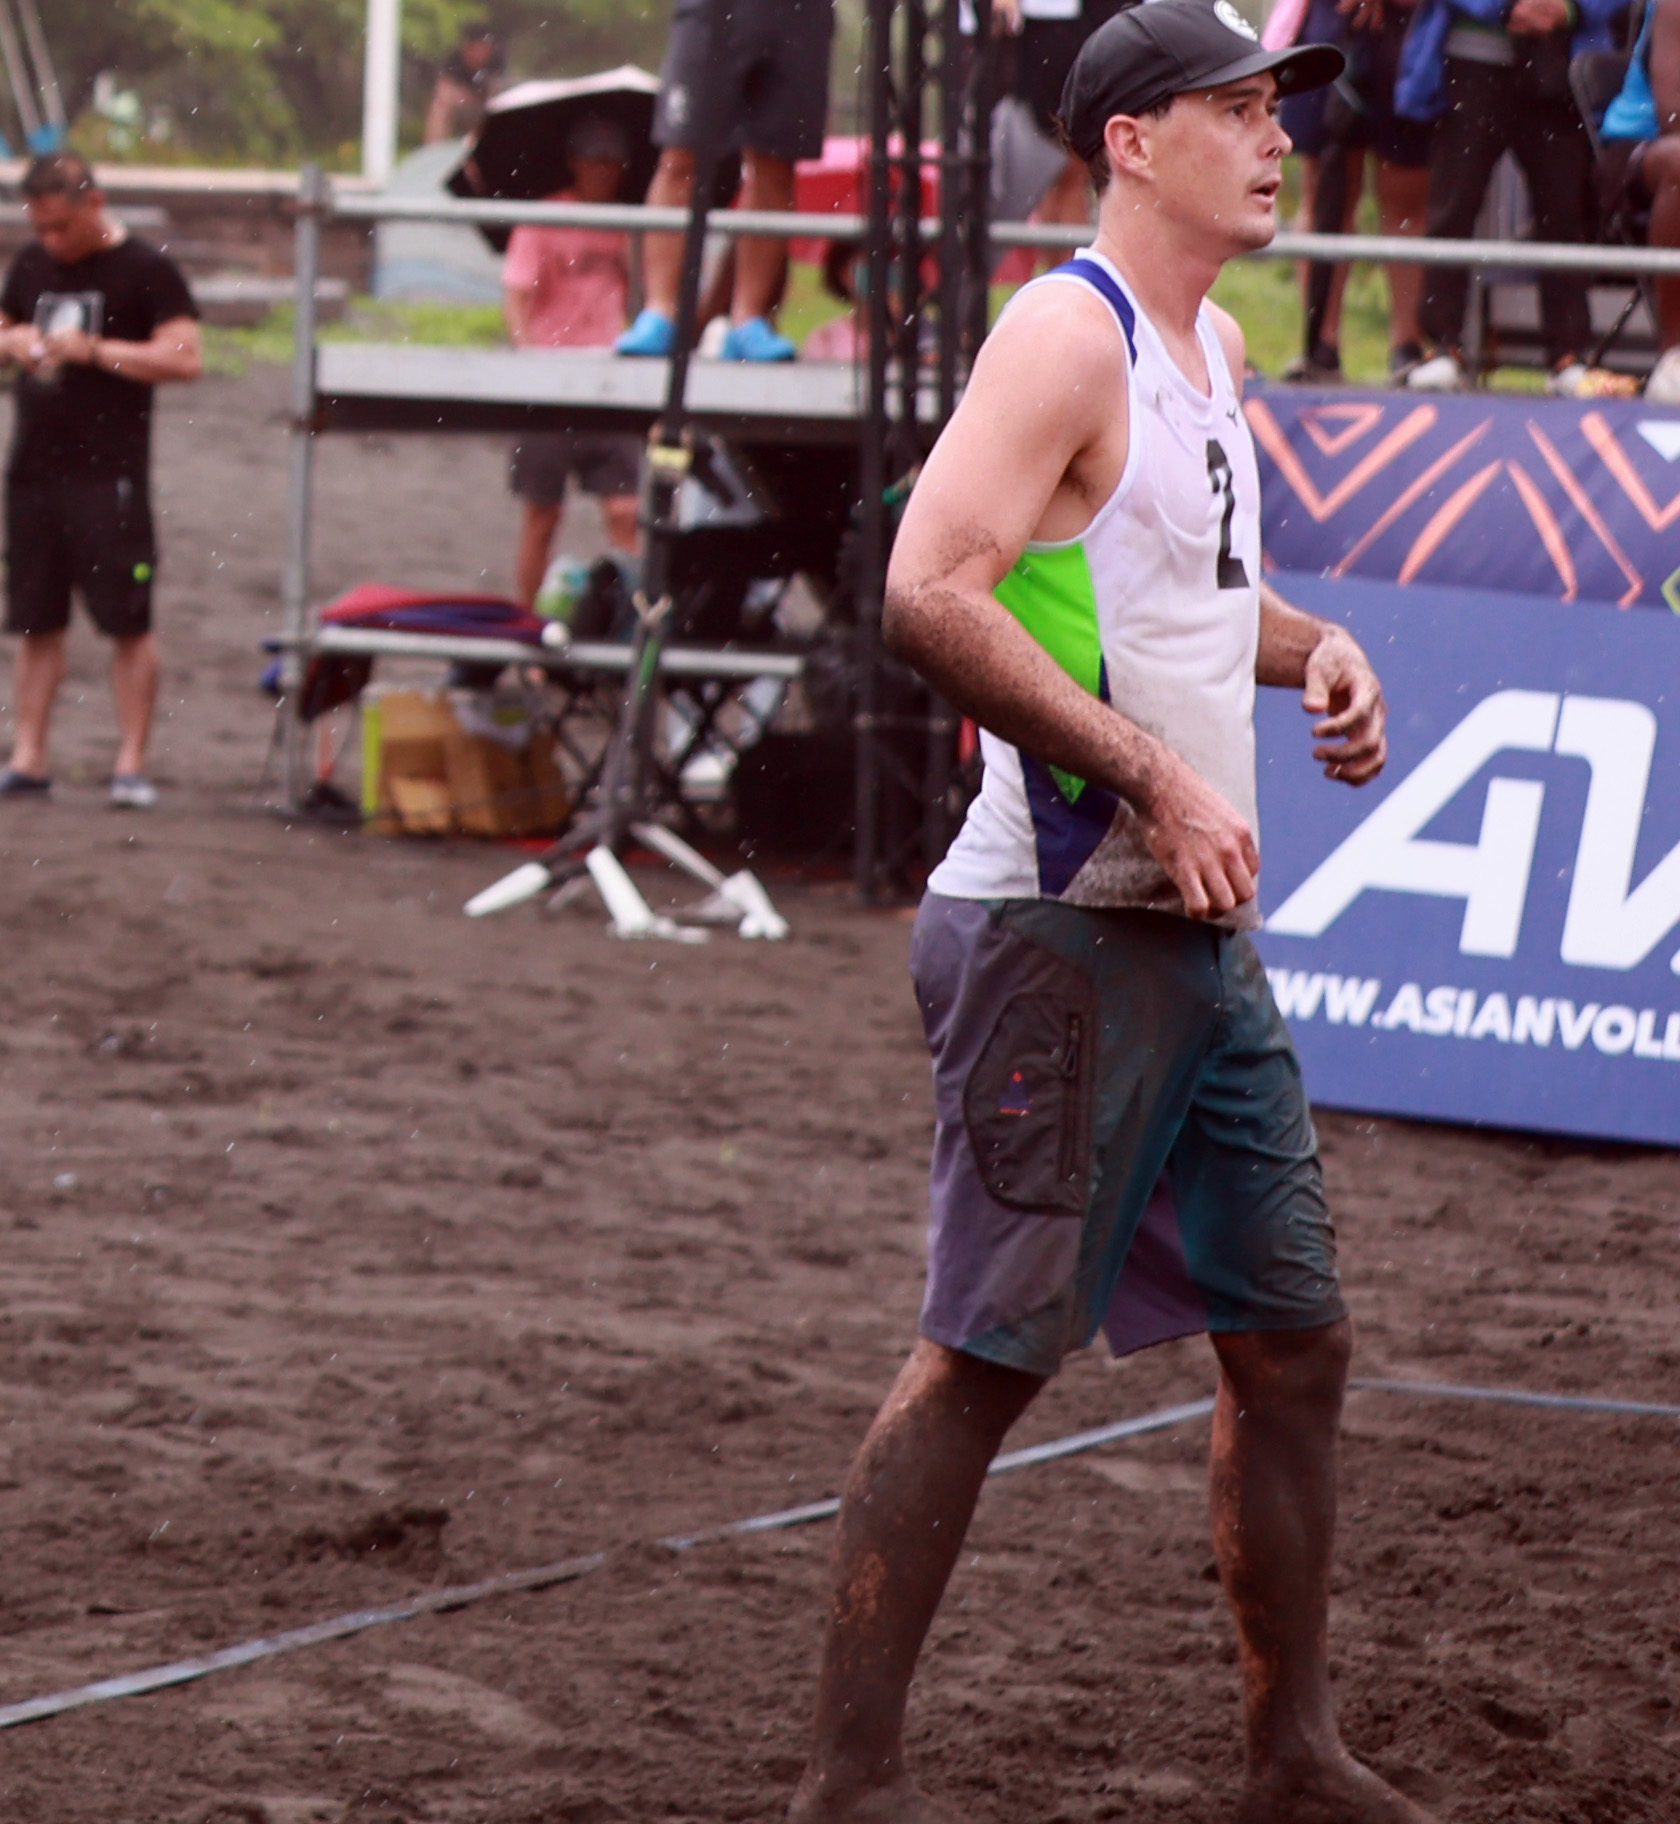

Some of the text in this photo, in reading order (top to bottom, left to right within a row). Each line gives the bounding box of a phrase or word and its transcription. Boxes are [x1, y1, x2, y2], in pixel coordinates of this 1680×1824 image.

[1205, 438, 1251, 589] 2
[1264, 688, 1680, 978] AV
[1264, 966, 1680, 1062] WW.ASIANVOLL
